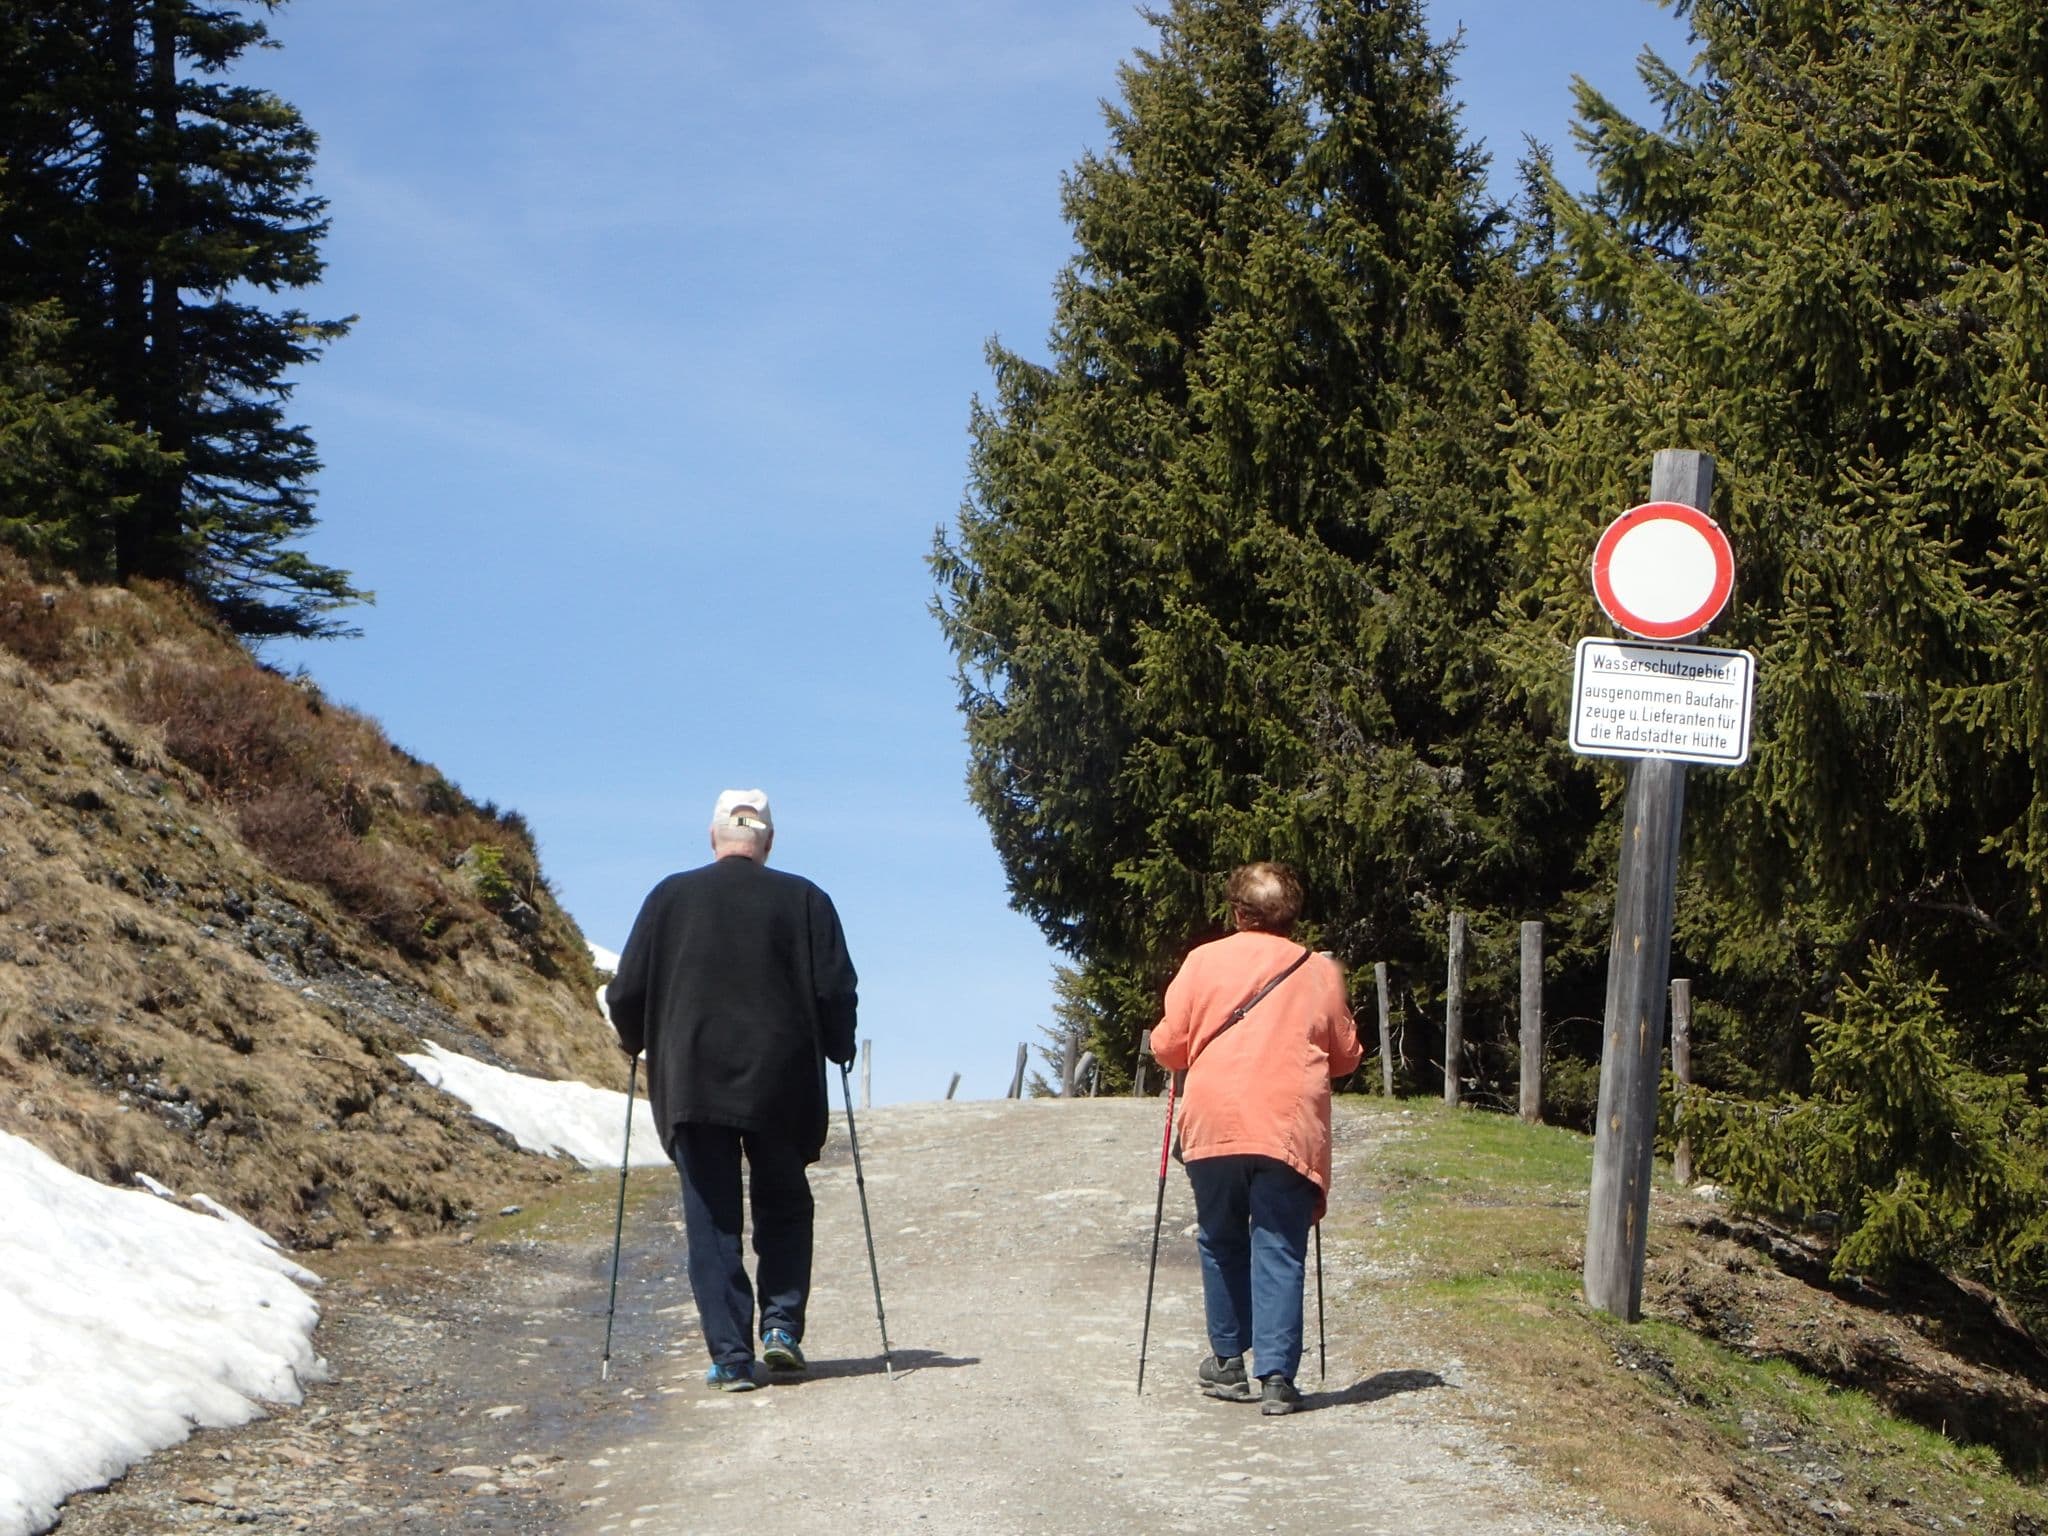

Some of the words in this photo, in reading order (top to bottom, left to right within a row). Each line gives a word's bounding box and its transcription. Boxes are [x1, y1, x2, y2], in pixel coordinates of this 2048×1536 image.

[1585, 686, 1681, 703] ausgenommen
[1685, 691, 1739, 709] Baufahr-
[1586, 706, 1625, 723] zeuge
[1642, 711, 1714, 727] Lieferanten
[1717, 715, 1736, 729] für
[1591, 724, 1611, 739] die
[1616, 726, 1687, 745] Radstädter
[1693, 732, 1727, 749] Hütte
